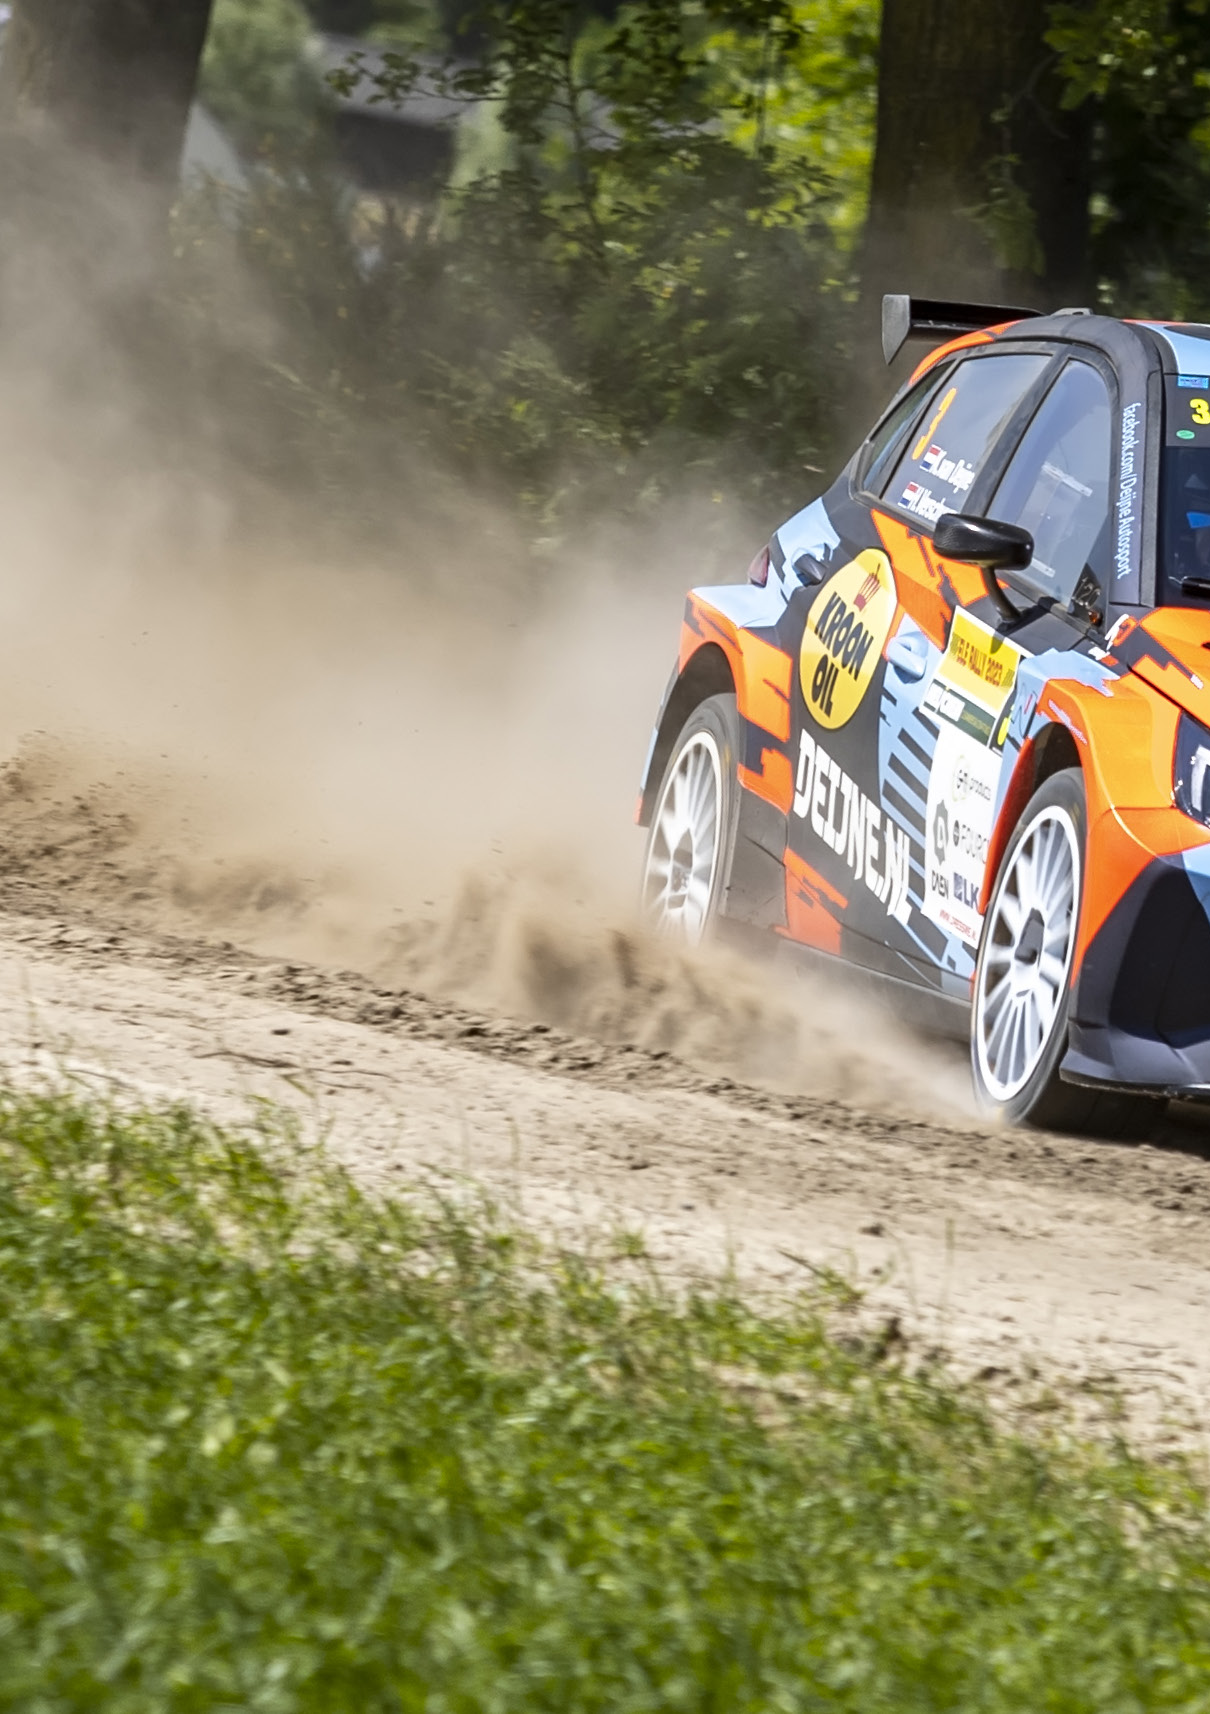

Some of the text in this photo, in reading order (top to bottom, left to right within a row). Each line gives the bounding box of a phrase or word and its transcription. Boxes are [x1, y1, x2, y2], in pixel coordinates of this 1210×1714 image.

[1190, 398, 1210, 425] 3
[814, 591, 874, 672] KROON
[811, 654, 840, 718] OIL
[984, 657, 1003, 687] 2023
[793, 728, 912, 925] DEIJNE.NL
